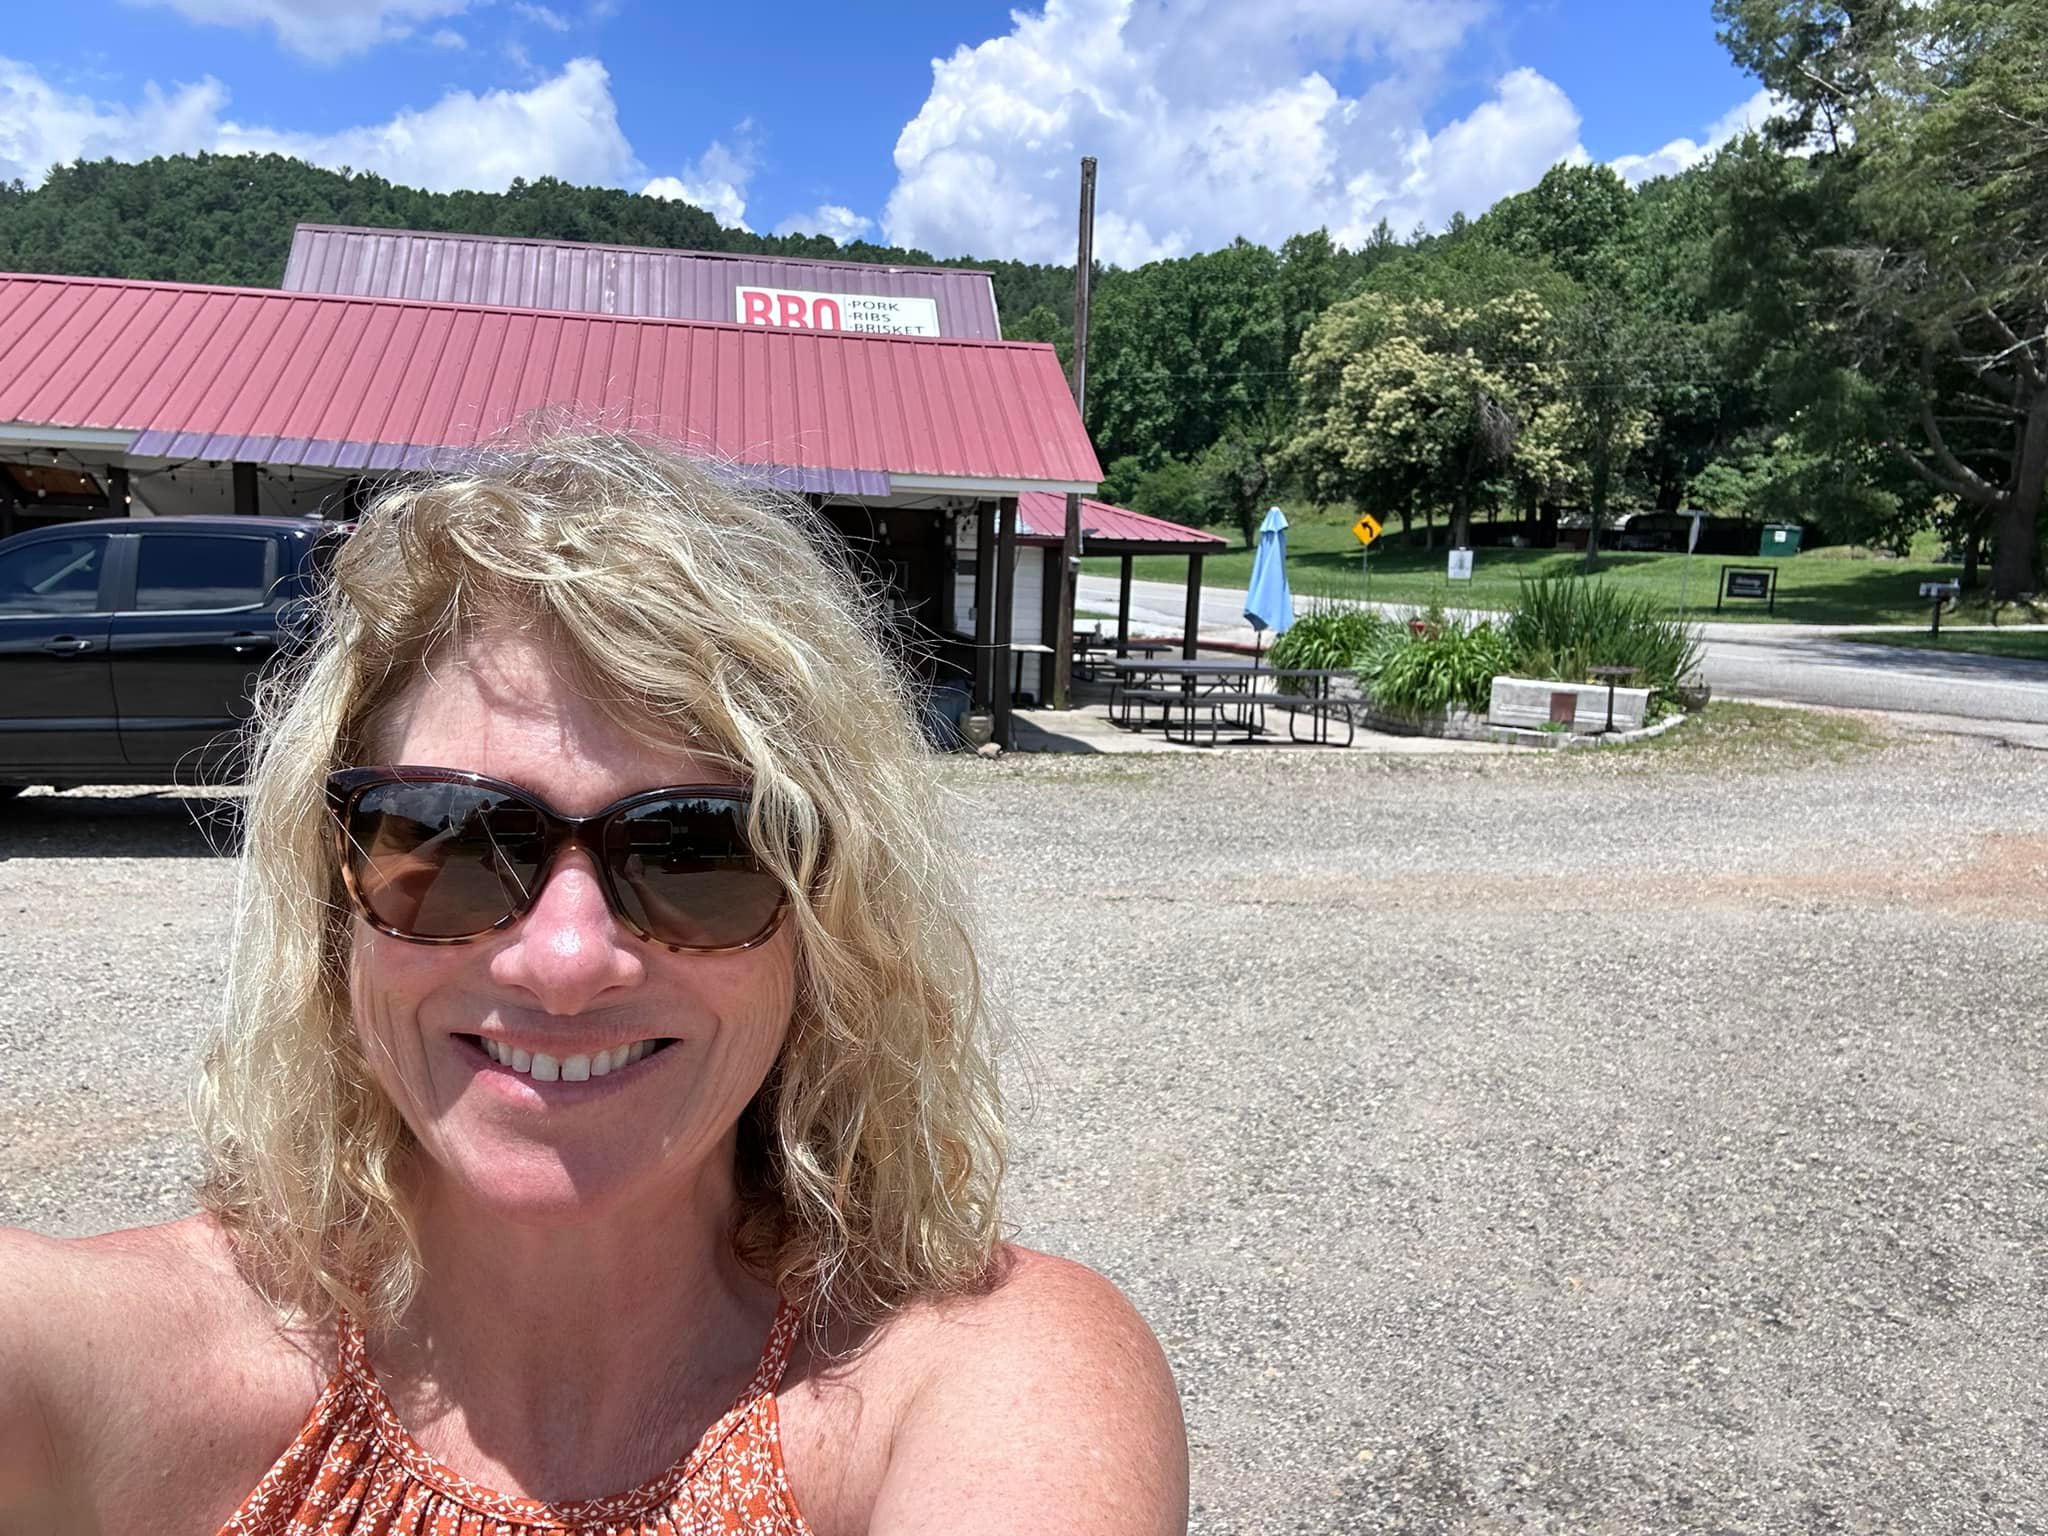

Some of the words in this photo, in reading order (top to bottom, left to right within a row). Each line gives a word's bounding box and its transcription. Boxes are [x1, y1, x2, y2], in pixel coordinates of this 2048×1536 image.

[852, 300, 900, 312] PORK
[853, 312, 891, 322] RIBS
[854, 323, 925, 335] BRISKET
